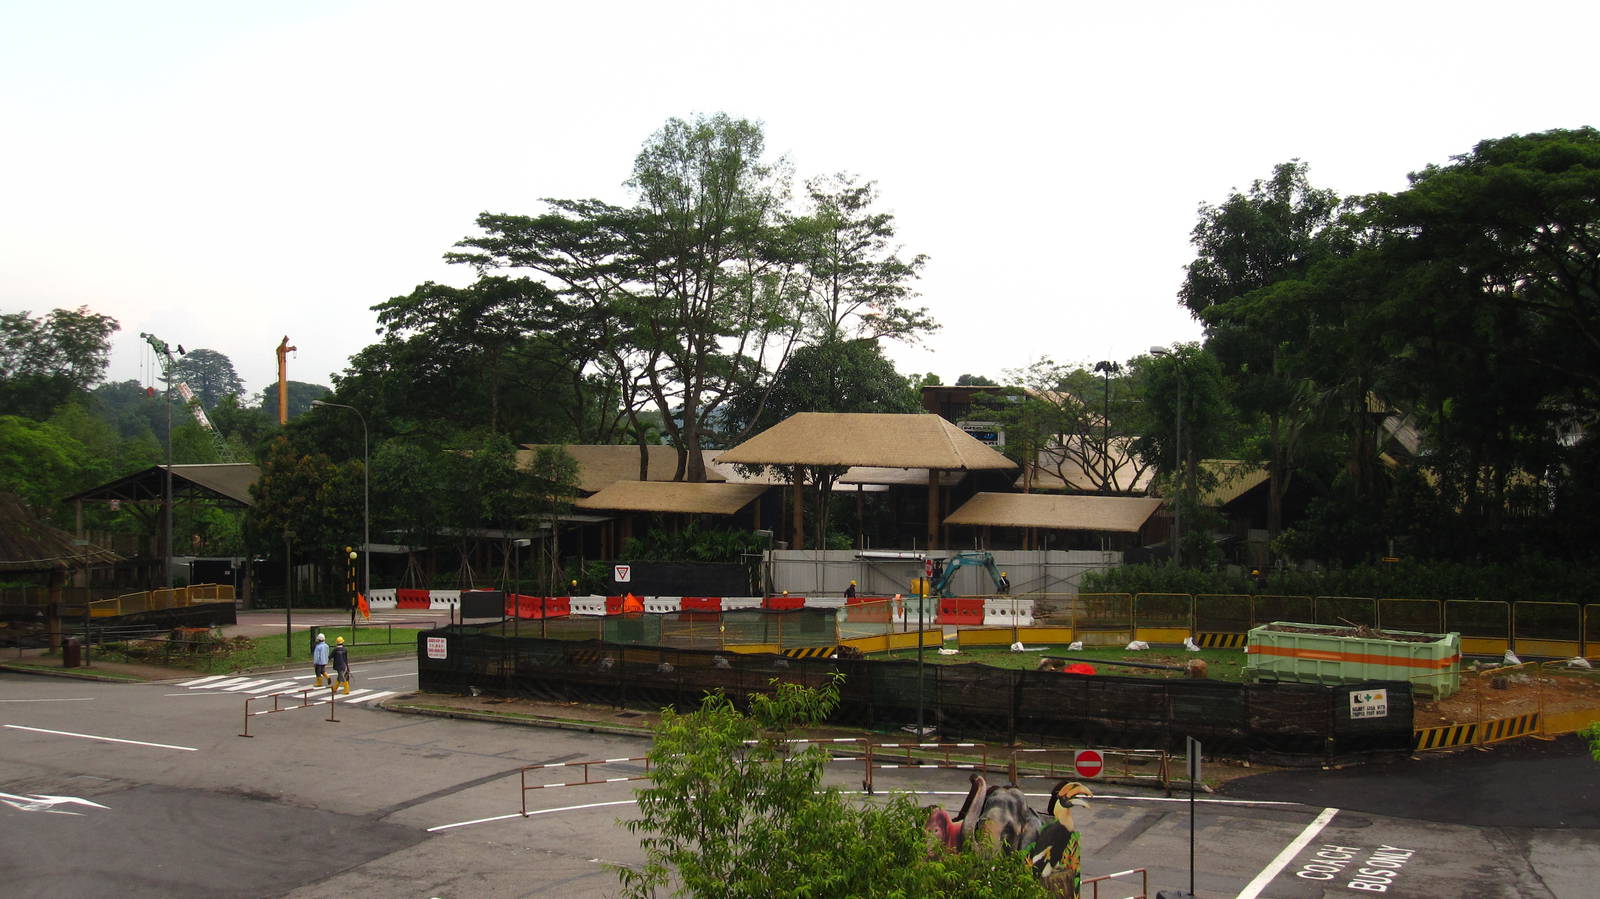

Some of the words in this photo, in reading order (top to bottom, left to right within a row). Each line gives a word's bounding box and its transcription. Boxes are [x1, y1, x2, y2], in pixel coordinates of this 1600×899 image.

[1296, 844, 1361, 880] COACH
[1365, 844, 1416, 869] ONLY
[1347, 867, 1398, 892] BUS
